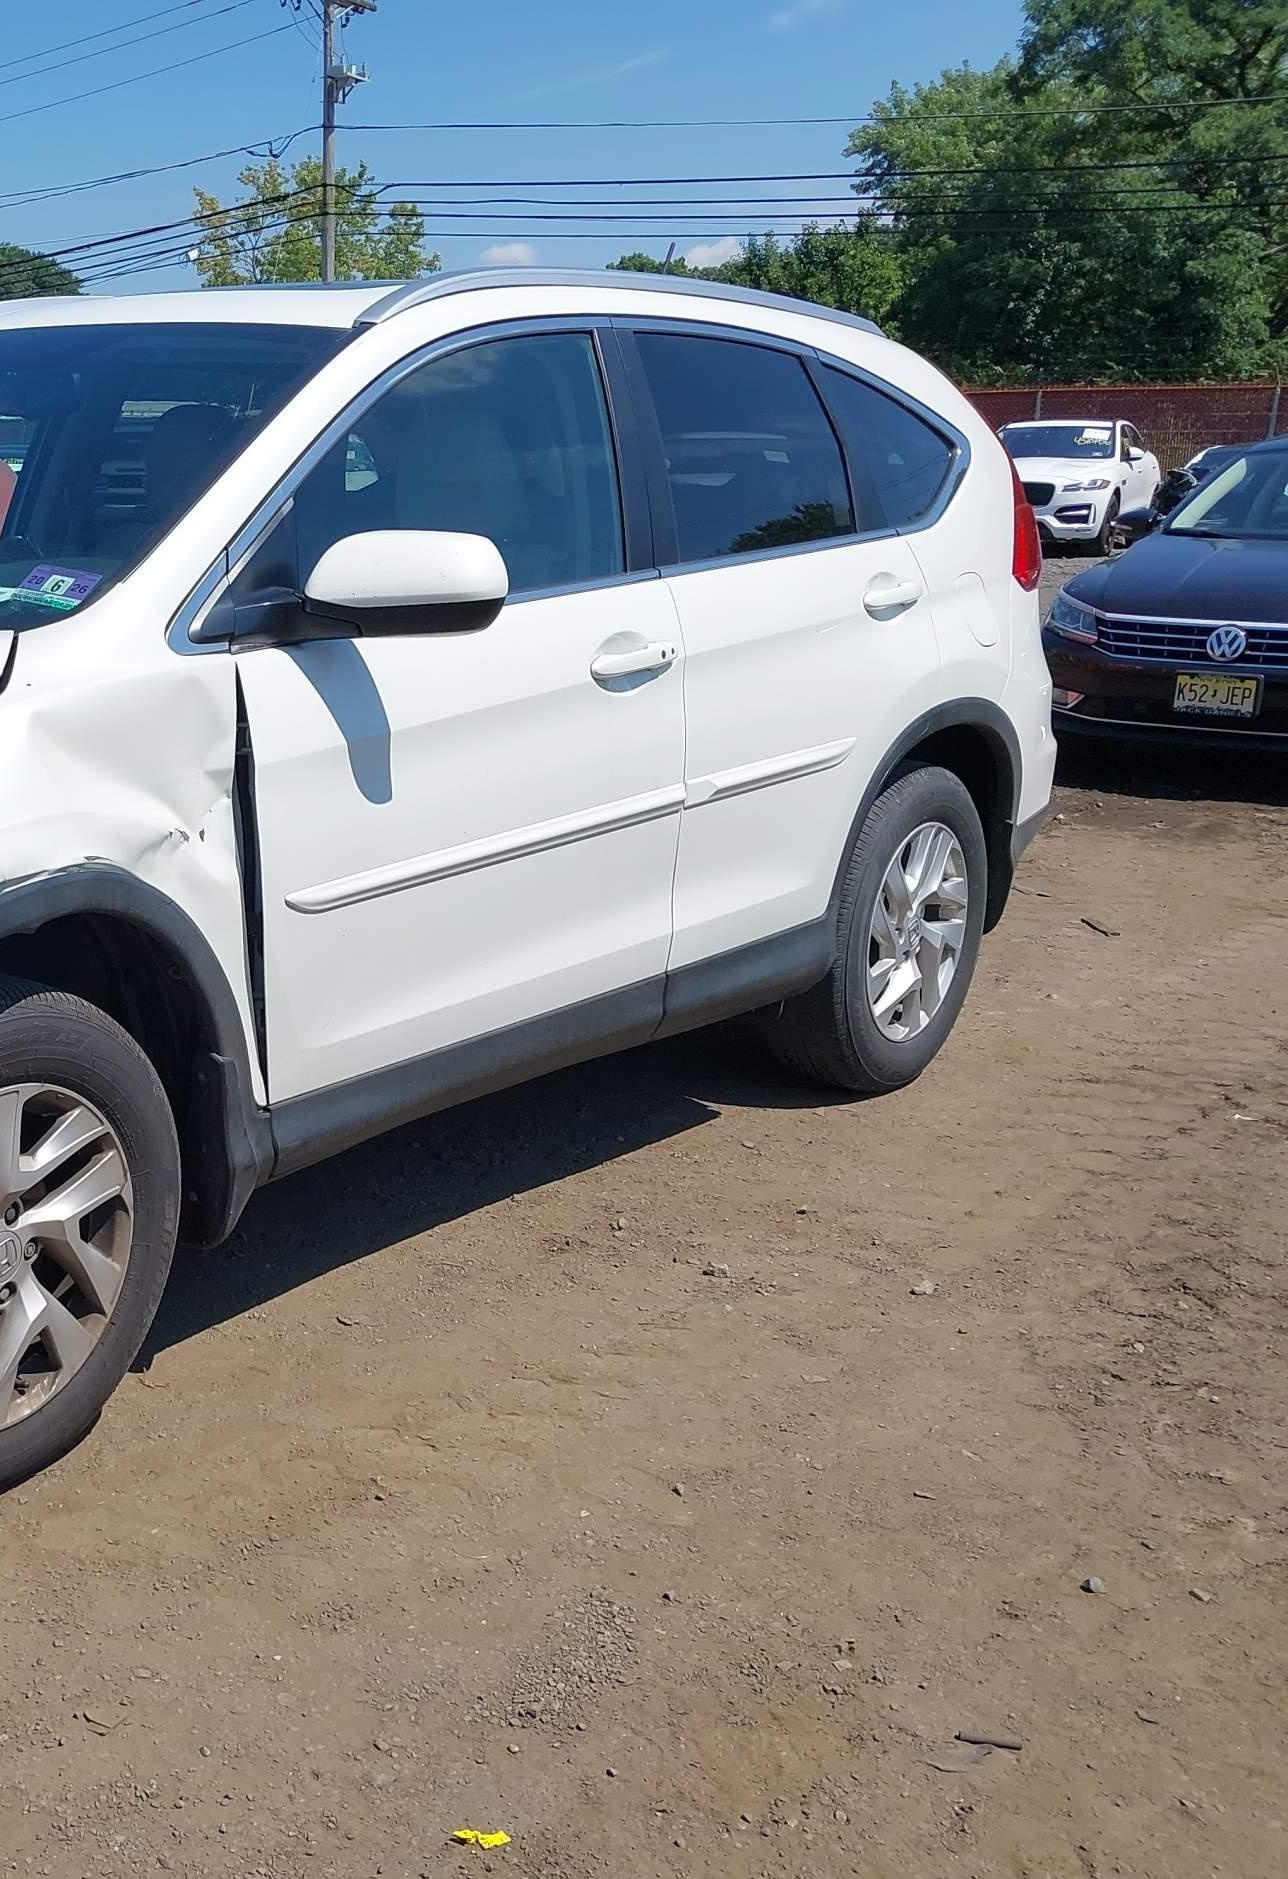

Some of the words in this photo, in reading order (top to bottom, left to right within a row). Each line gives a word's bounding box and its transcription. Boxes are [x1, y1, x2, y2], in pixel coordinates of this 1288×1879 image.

[27, 575, 45, 585] 20
[51, 579, 65, 593] 6
[70, 583, 88, 594] 26
[1176, 682, 1209, 703] K52
[1220, 685, 1252, 706] JEP
